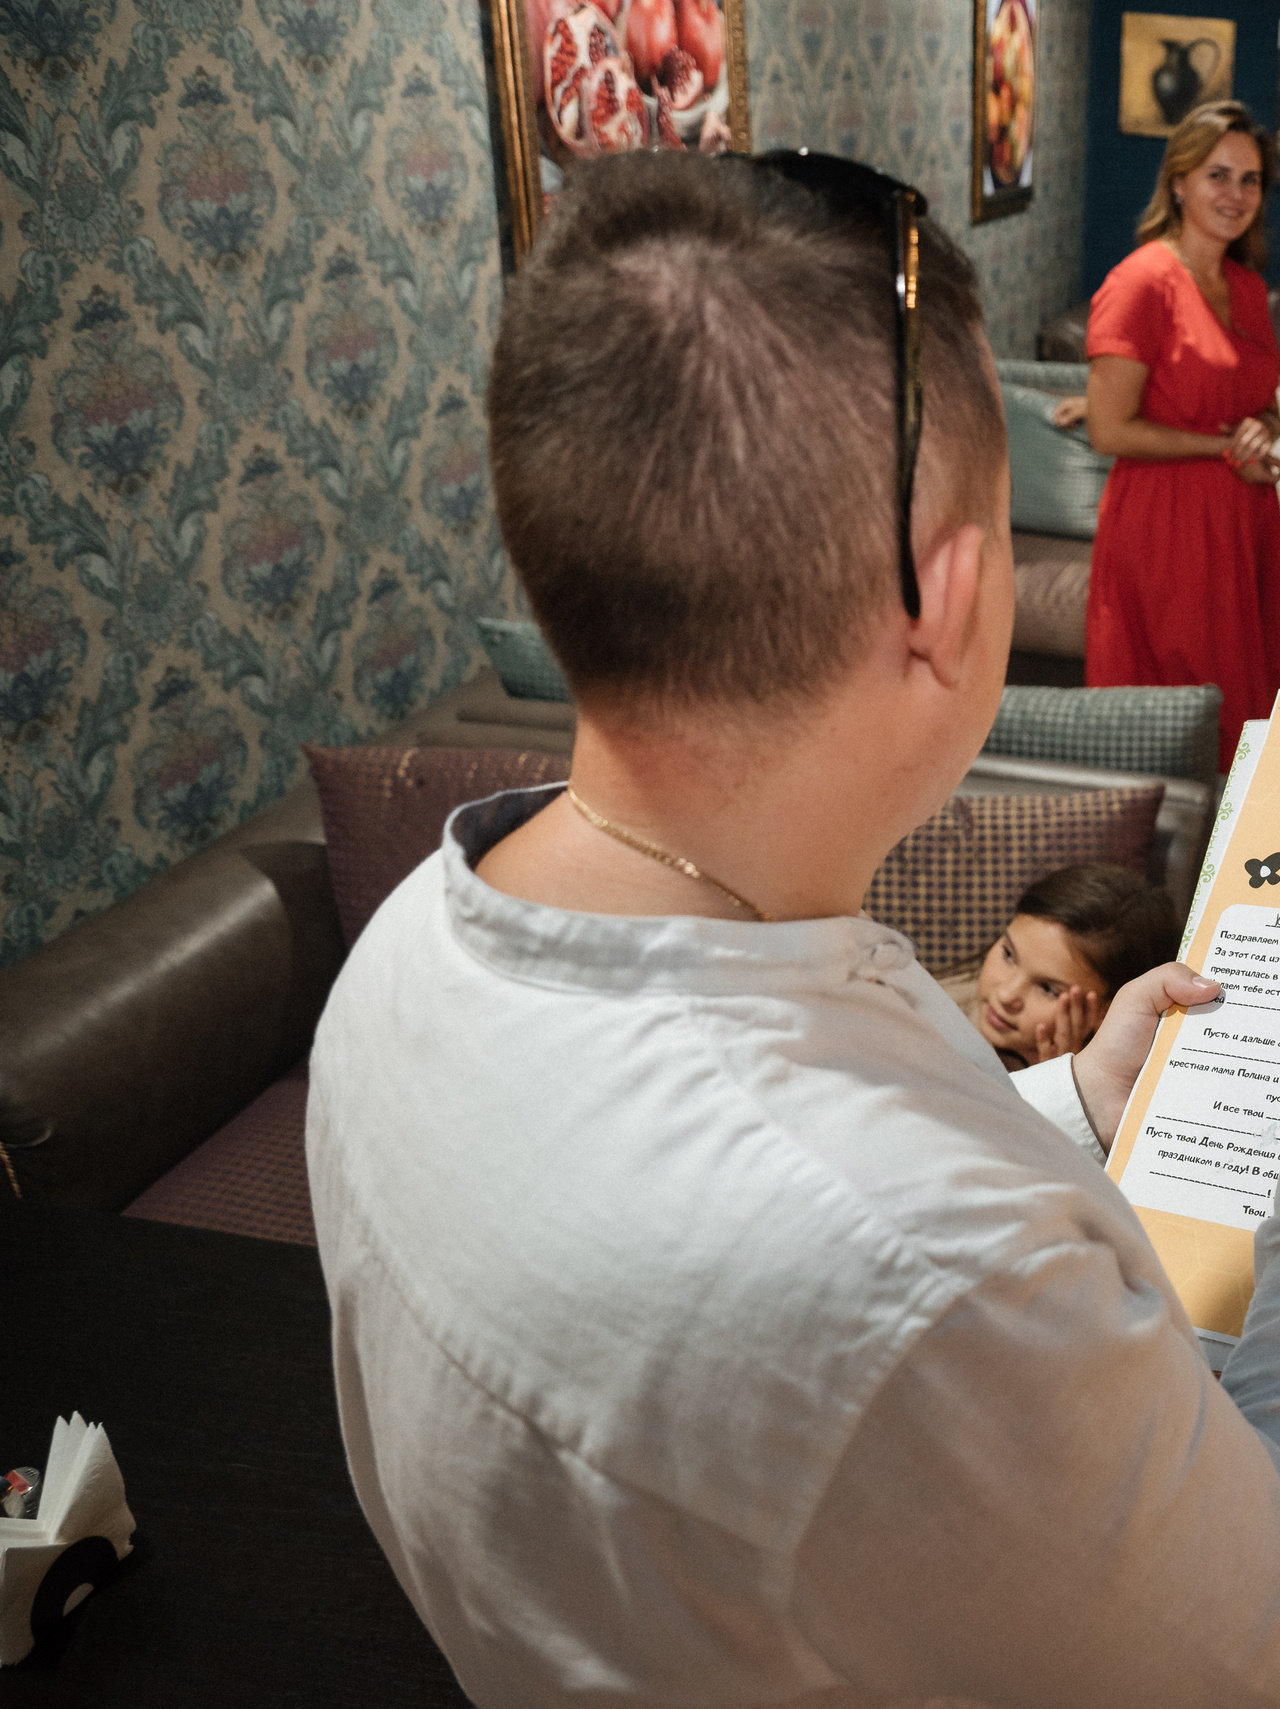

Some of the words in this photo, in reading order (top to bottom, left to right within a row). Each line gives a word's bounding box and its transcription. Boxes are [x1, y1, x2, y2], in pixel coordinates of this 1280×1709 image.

[1220, 930, 1279, 946] Поздравляем
[1214, 946, 1226, 957] За
[1228, 950, 1249, 959] этот
[1250, 954, 1266, 963] год
[1268, 955, 1280, 963] из
[1210, 965, 1270, 980] превратилась
[1242, 984, 1263, 994] тебе
[1203, 1027, 1230, 1039] Пусть
[1240, 1035, 1276, 1046] дальше
[1168, 1059, 1210, 1071] крестная
[1211, 1066, 1235, 1076] мама
[1237, 1068, 1271, 1082] Полина
[1213, 1100, 1222, 1111] И
[1223, 1104, 1240, 1113] все
[1242, 1108, 1265, 1118] твои
[1146, 1126, 1173, 1139] Пусть
[1176, 1133, 1197, 1144] твой
[1198, 1136, 1224, 1149] День
[1226, 1142, 1276, 1159] Рождения
[1157, 1149, 1213, 1166] праздником
[1222, 1162, 1250, 1175] году!
[1252, 1166, 1260, 1176] В
[1242, 1205, 1266, 1218] Твои
